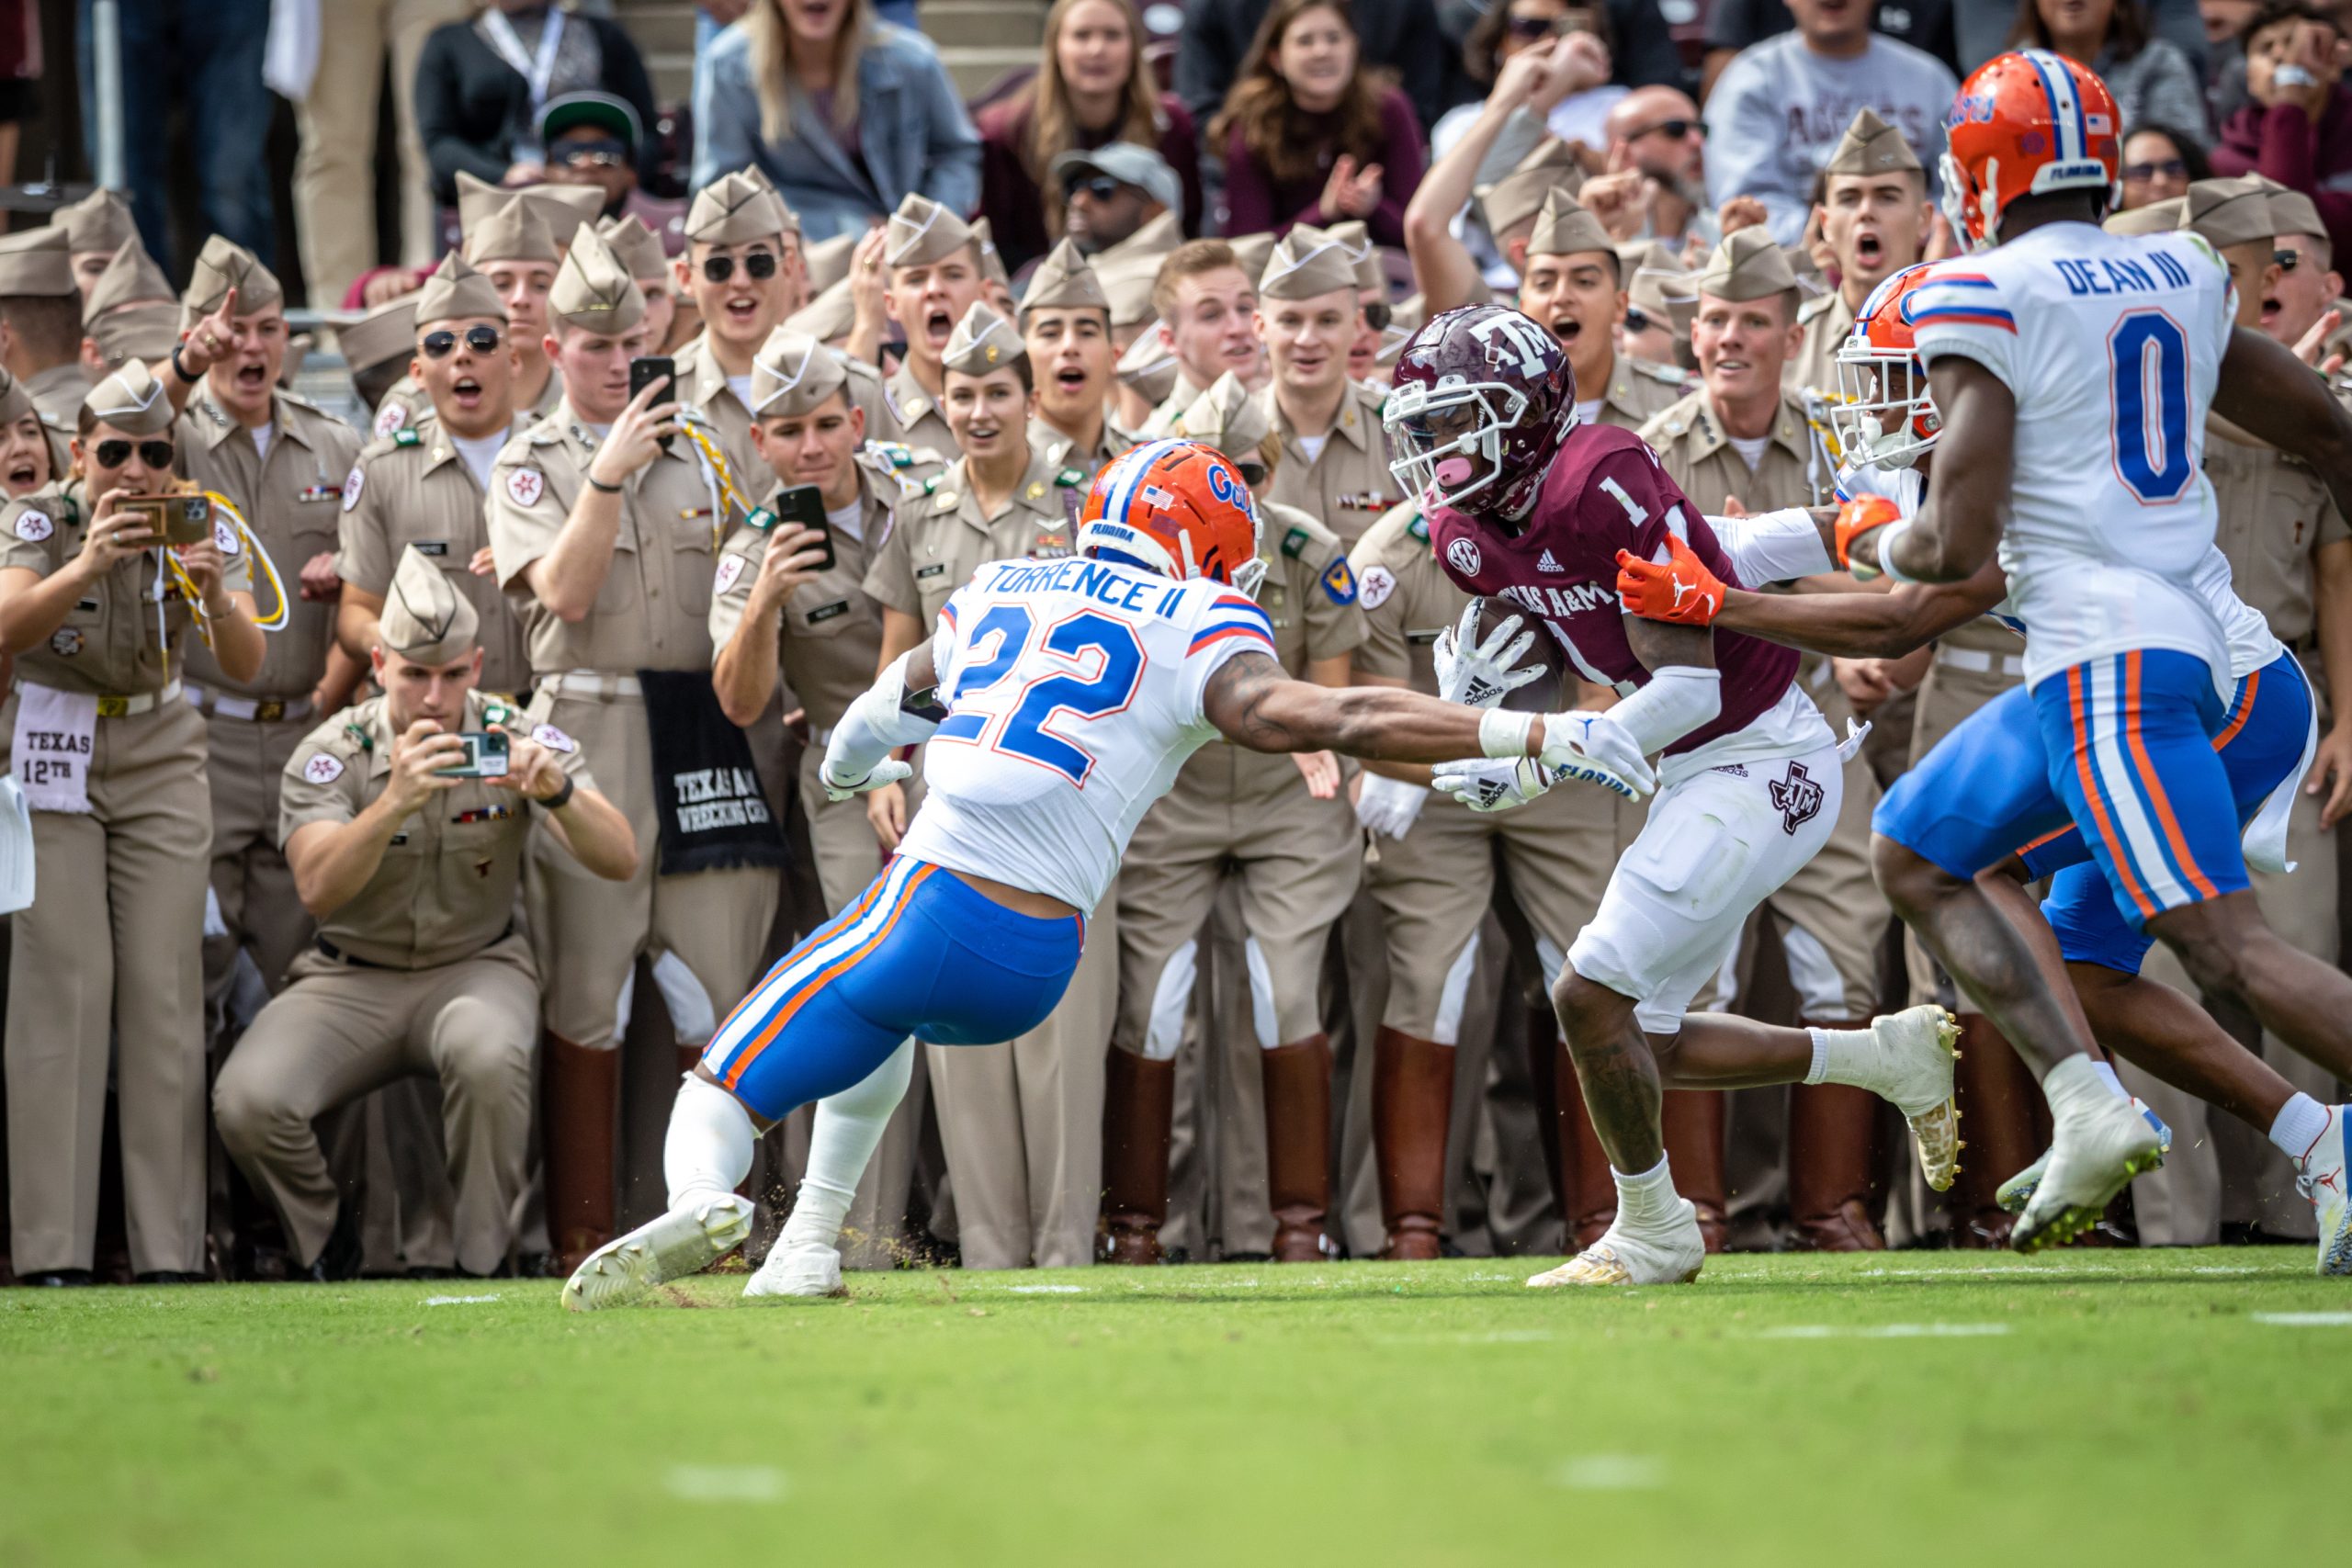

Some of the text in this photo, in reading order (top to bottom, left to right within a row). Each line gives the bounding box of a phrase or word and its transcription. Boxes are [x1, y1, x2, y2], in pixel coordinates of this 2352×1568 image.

[2052, 250, 2190, 295] DEAN III
[2106, 306, 2196, 507] 0
[1599, 477, 1649, 528] 1
[1091, 523, 1135, 543] FLORIDA
[1449, 539, 1481, 576] SEC
[1536, 563, 1565, 572] adidas
[984, 560, 1187, 619] TORRENCE II
[1544, 582, 1614, 617] A&M
[930, 602, 1148, 791] 22
[1464, 685, 1504, 706] adidas
[27, 731, 91, 754] TEXAS
[23, 760, 72, 785] 12TH
[1483, 781, 1510, 808] adidas
